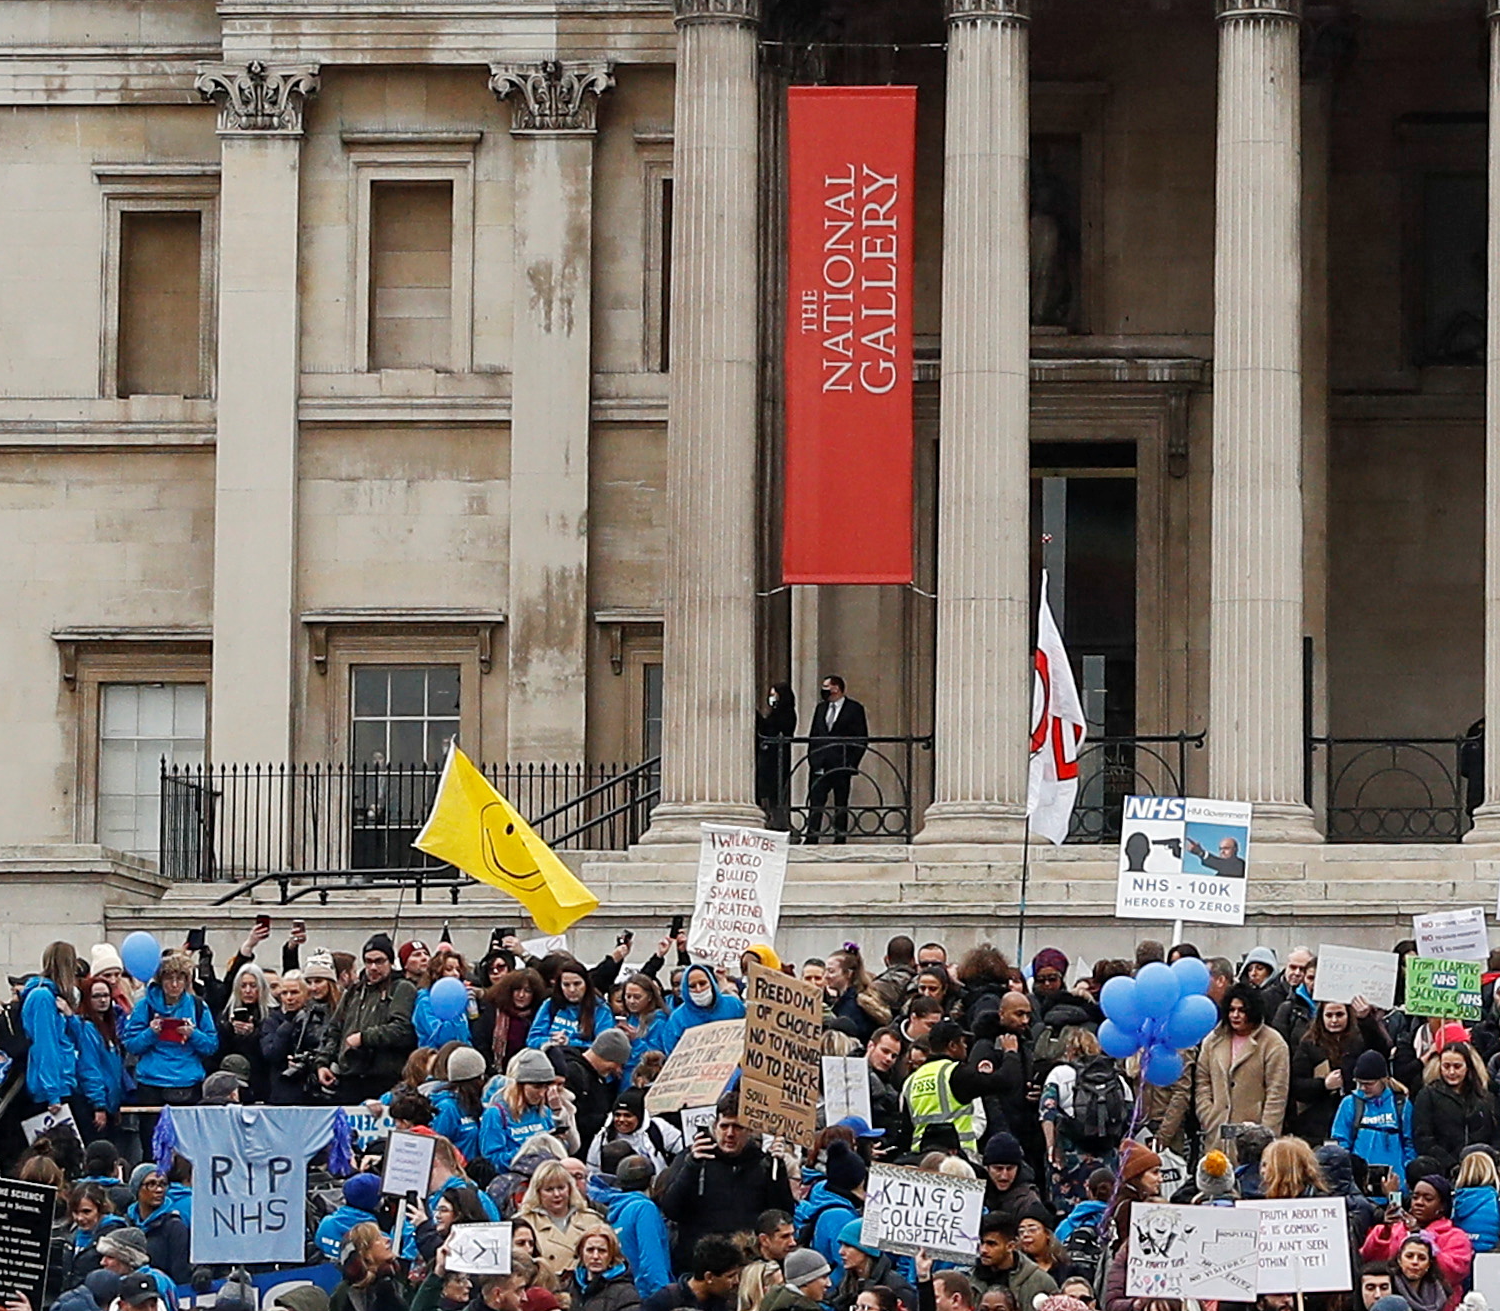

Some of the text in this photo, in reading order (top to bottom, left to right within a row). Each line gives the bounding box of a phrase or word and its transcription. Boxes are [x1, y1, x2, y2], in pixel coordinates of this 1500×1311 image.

[822, 162, 855, 394] NATIONAL
[860, 162, 898, 394] GALLERY
[802, 289, 817, 335] THE
[1127, 798, 1184, 819] NHS
[1203, 809, 1249, 820] Government
[1133, 878, 1231, 897] NHS 100K
[1125, 897, 1240, 913] HEROES TO ZEROS
[1413, 958, 1434, 970] From
[1432, 973, 1457, 986] NHS
[755, 977, 816, 1015] FREEDOM
[1456, 992, 1482, 1006] NHS
[757, 1004, 822, 1040] OF CHOICE
[750, 1027, 783, 1052] NO TO
[746, 1048, 764, 1070] NO
[765, 1056, 783, 1077] TO
[783, 1063, 818, 1091] BLACK
[744, 1088, 769, 1107] SOUL
[781, 1082, 812, 1107] MAIL
[743, 1105, 804, 1136] DESTROYING
[211, 1156, 292, 1195] RIP
[11, 1188, 45, 1202] SCIENCE
[882, 1178, 966, 1213] KINGS
[212, 1197, 289, 1238] NHS
[881, 1206, 963, 1231] COLLEGE
[1291, 1209, 1320, 1219] ABOUT
[1322, 1208, 1337, 1219] THE
[886, 1227, 958, 1247] HOSPITAL
[1272, 1224, 1320, 1235] IS COMING
[1307, 1240, 1329, 1251] SEEN
